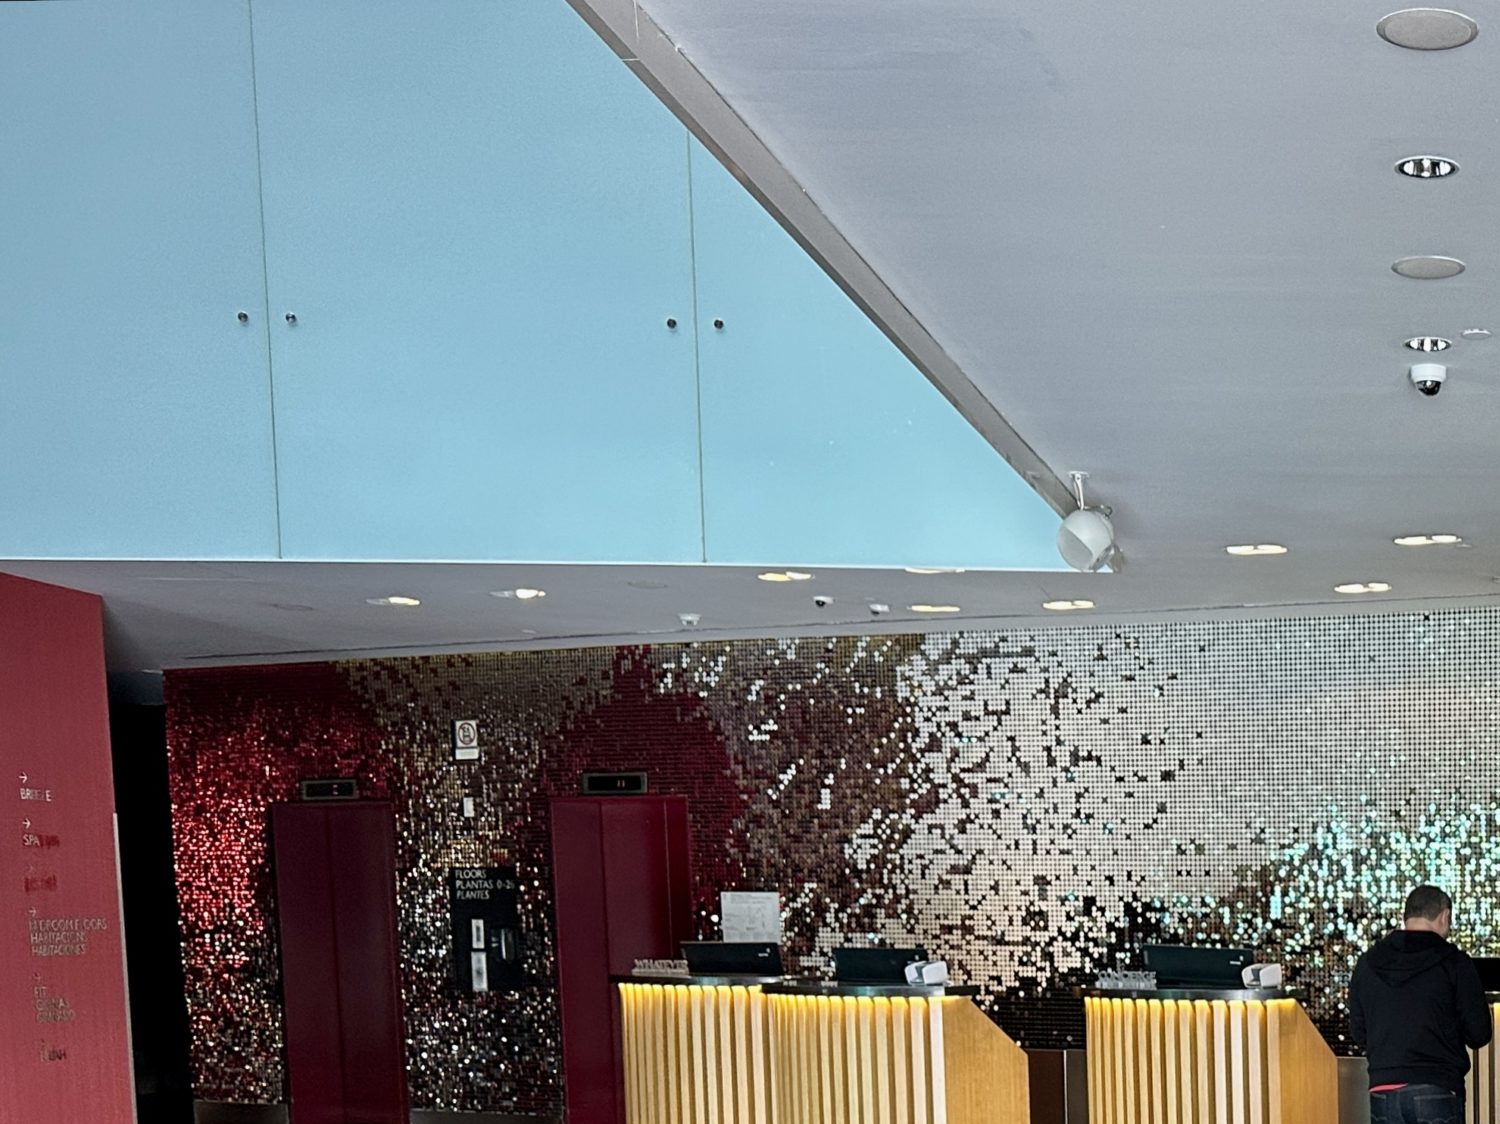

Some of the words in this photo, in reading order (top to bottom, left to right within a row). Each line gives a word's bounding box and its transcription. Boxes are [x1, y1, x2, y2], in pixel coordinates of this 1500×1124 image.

[455, 869, 486, 879] FLOORS
[455, 880, 493, 890] PLANTAS
[456, 890, 490, 900] PLANTES
